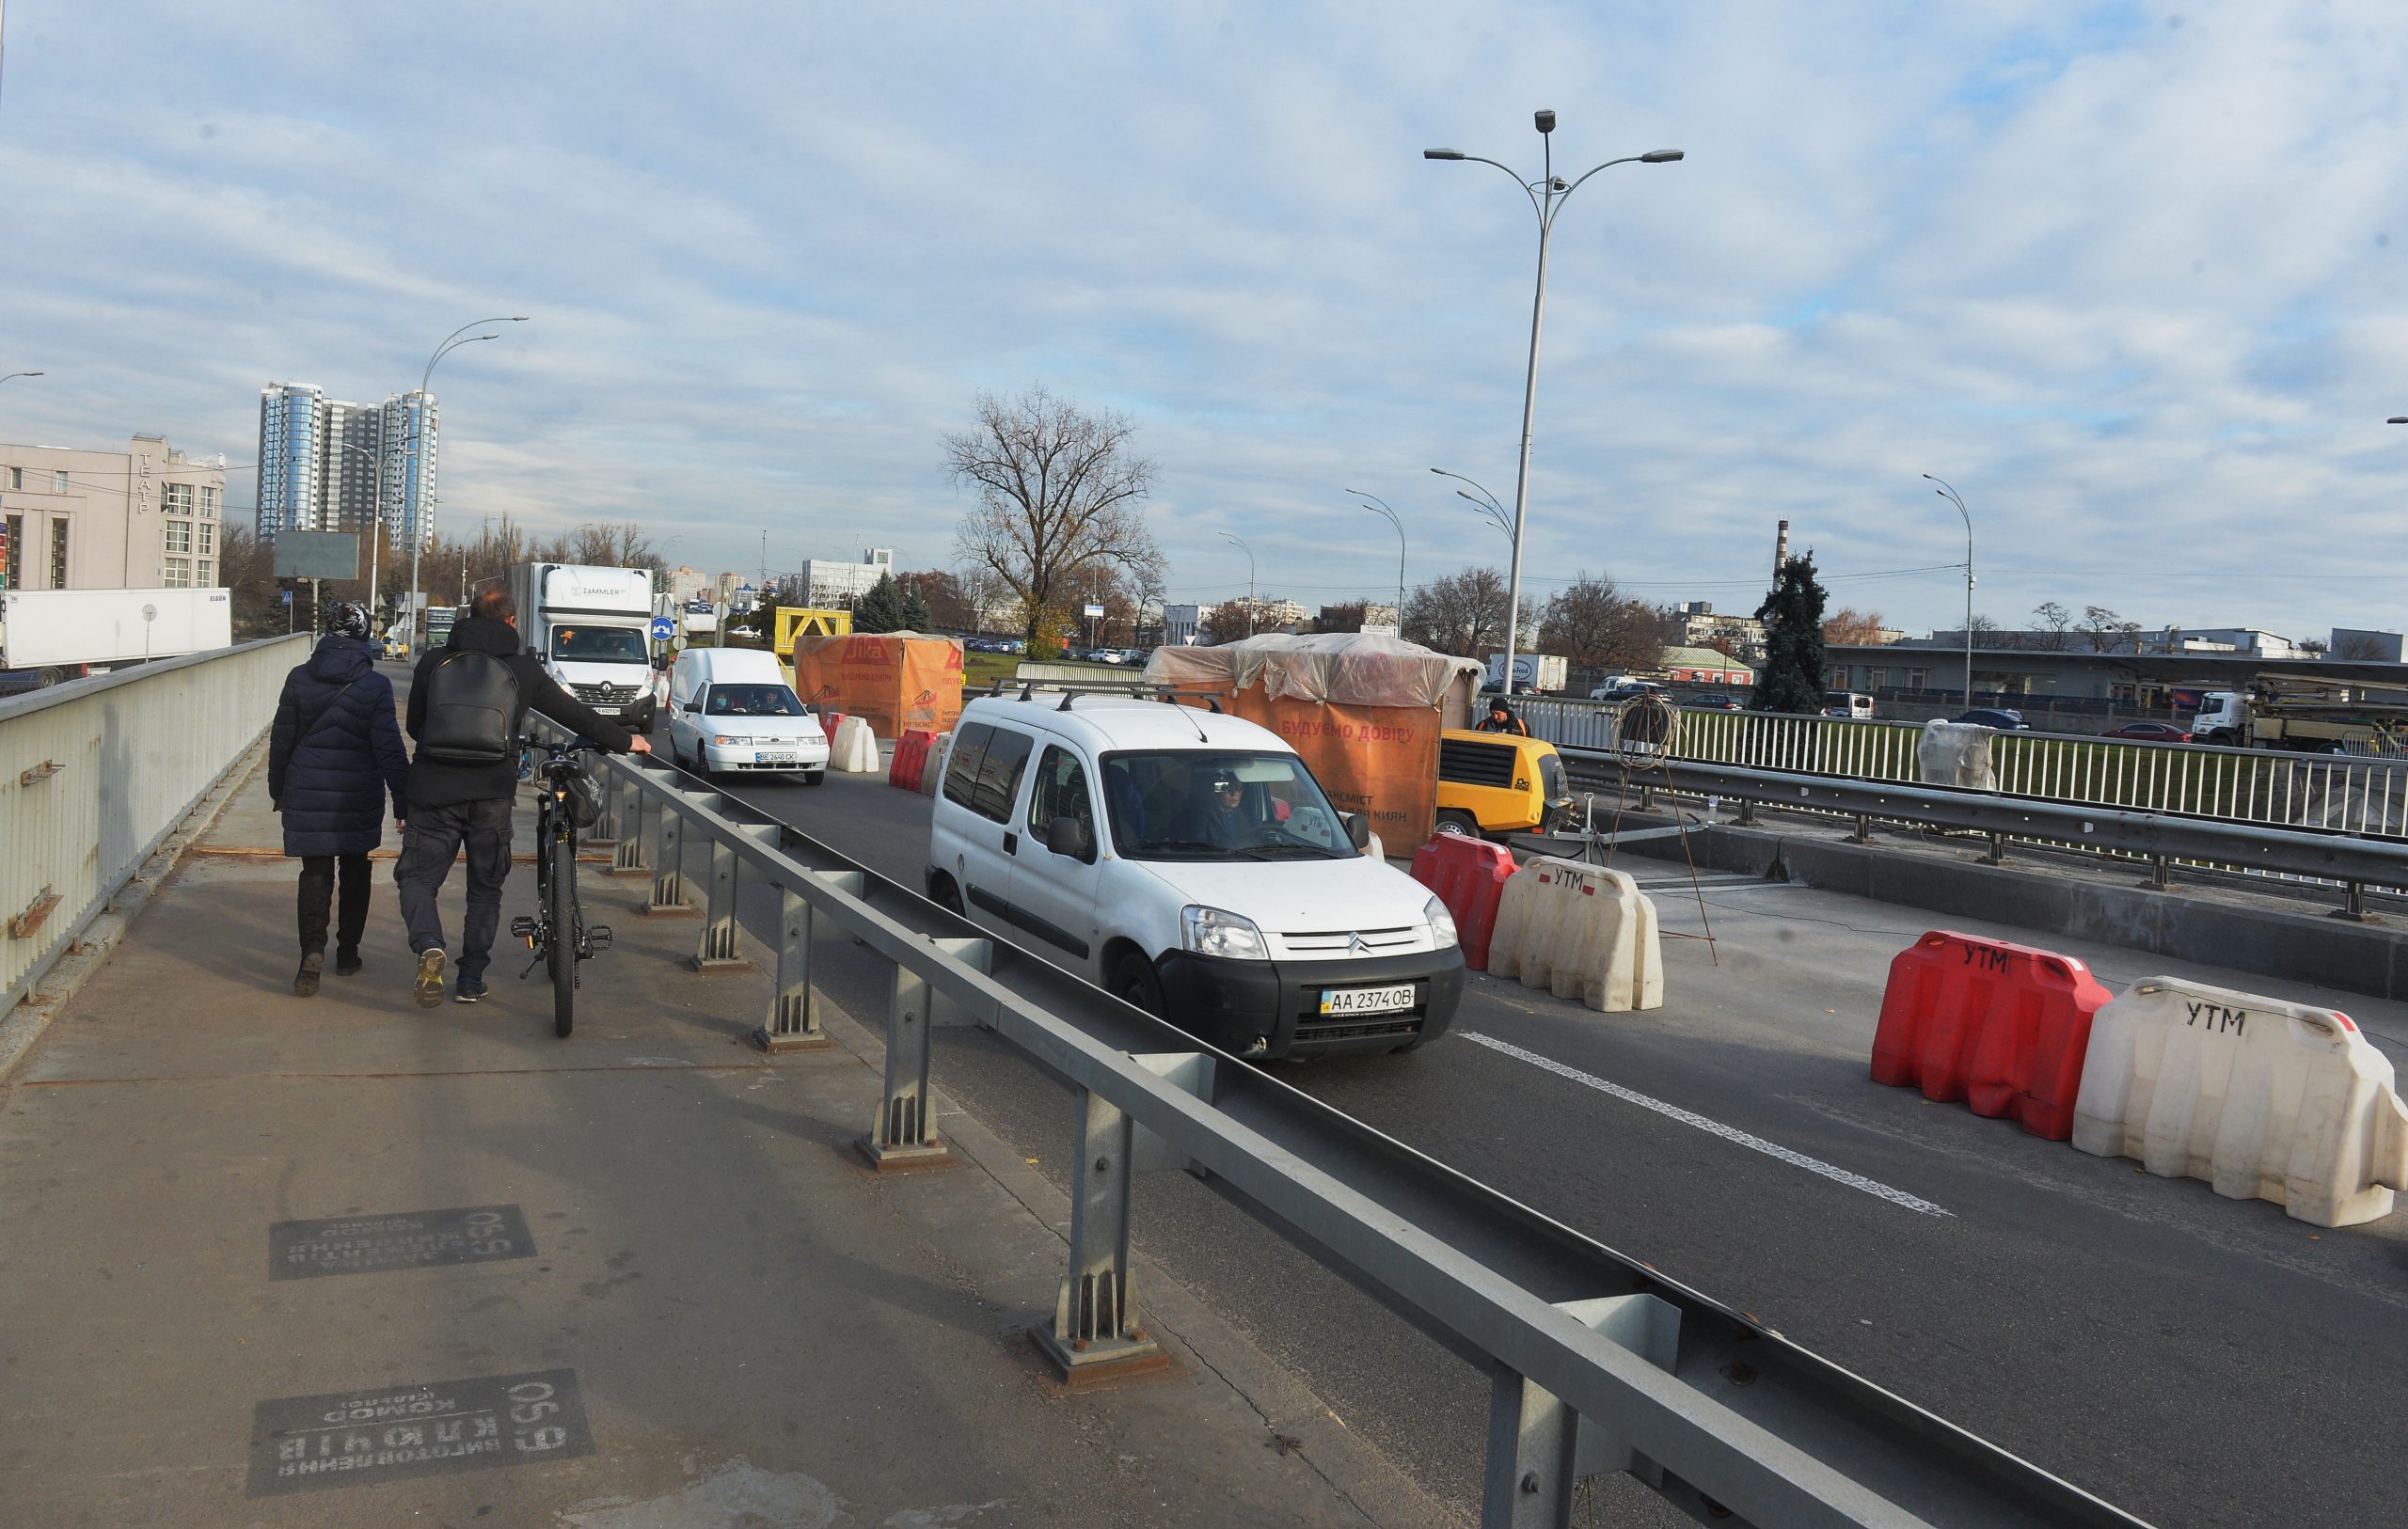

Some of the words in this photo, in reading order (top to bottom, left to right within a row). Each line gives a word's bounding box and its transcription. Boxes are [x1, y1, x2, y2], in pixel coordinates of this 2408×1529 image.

[138, 453, 150, 514] ТЕАТР
[1281, 720, 1353, 739] БУДУЄМО
[1358, 725, 1415, 744] ДОВІРУ
[1374, 810, 1407, 823] КИЯН
[1555, 867, 1584, 891] УТМ
[1964, 942, 2008, 973] УТМ
[1331, 993, 1353, 1010] AA
[1356, 991, 1390, 1009] 2374
[1392, 989, 1412, 1006] OB
[2187, 1001, 2245, 1036] УТМ
[277, 1415, 499, 1461] КЛЮЧІВ
